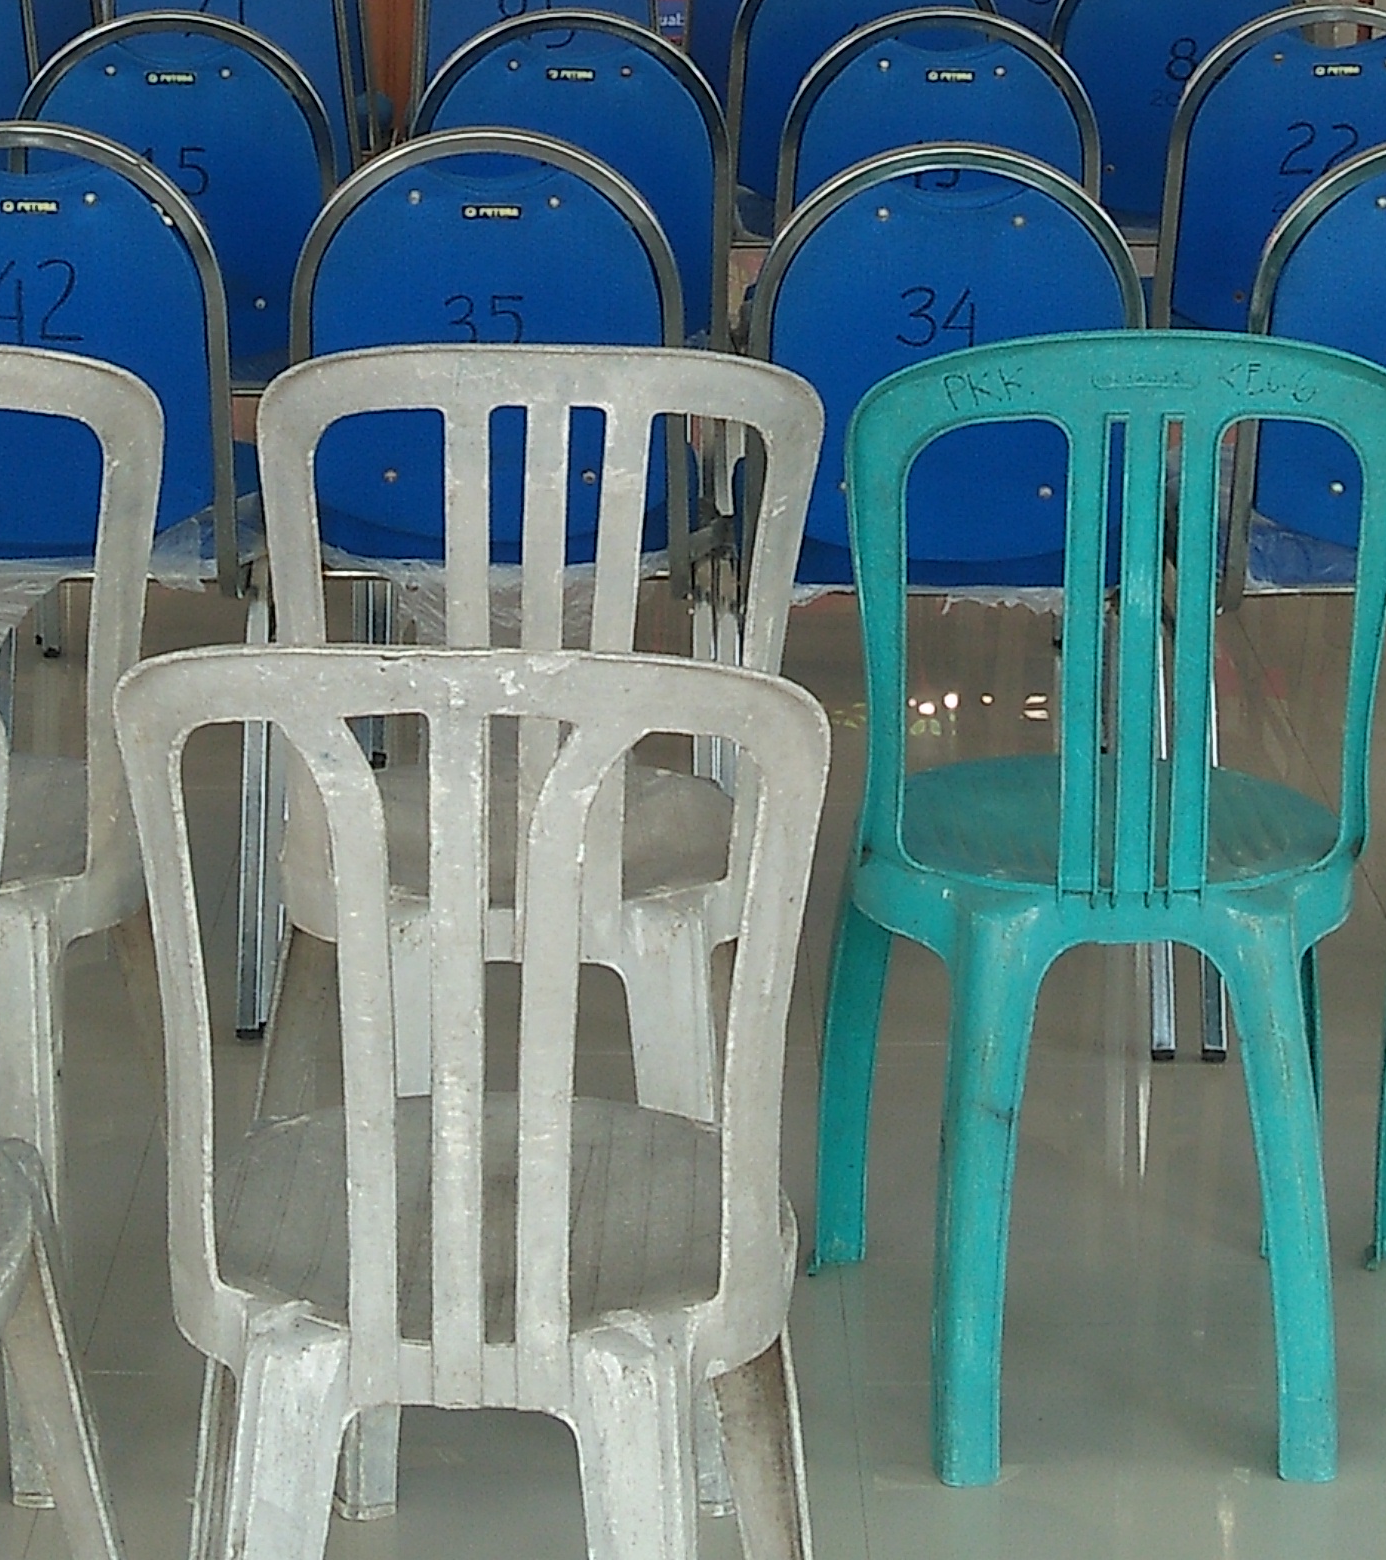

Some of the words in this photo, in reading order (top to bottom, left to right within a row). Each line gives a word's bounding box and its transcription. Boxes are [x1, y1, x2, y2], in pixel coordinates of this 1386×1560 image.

[1279, 121, 1360, 176] 22
[443, 294, 525, 344] 35
[895, 285, 976, 348] 34
